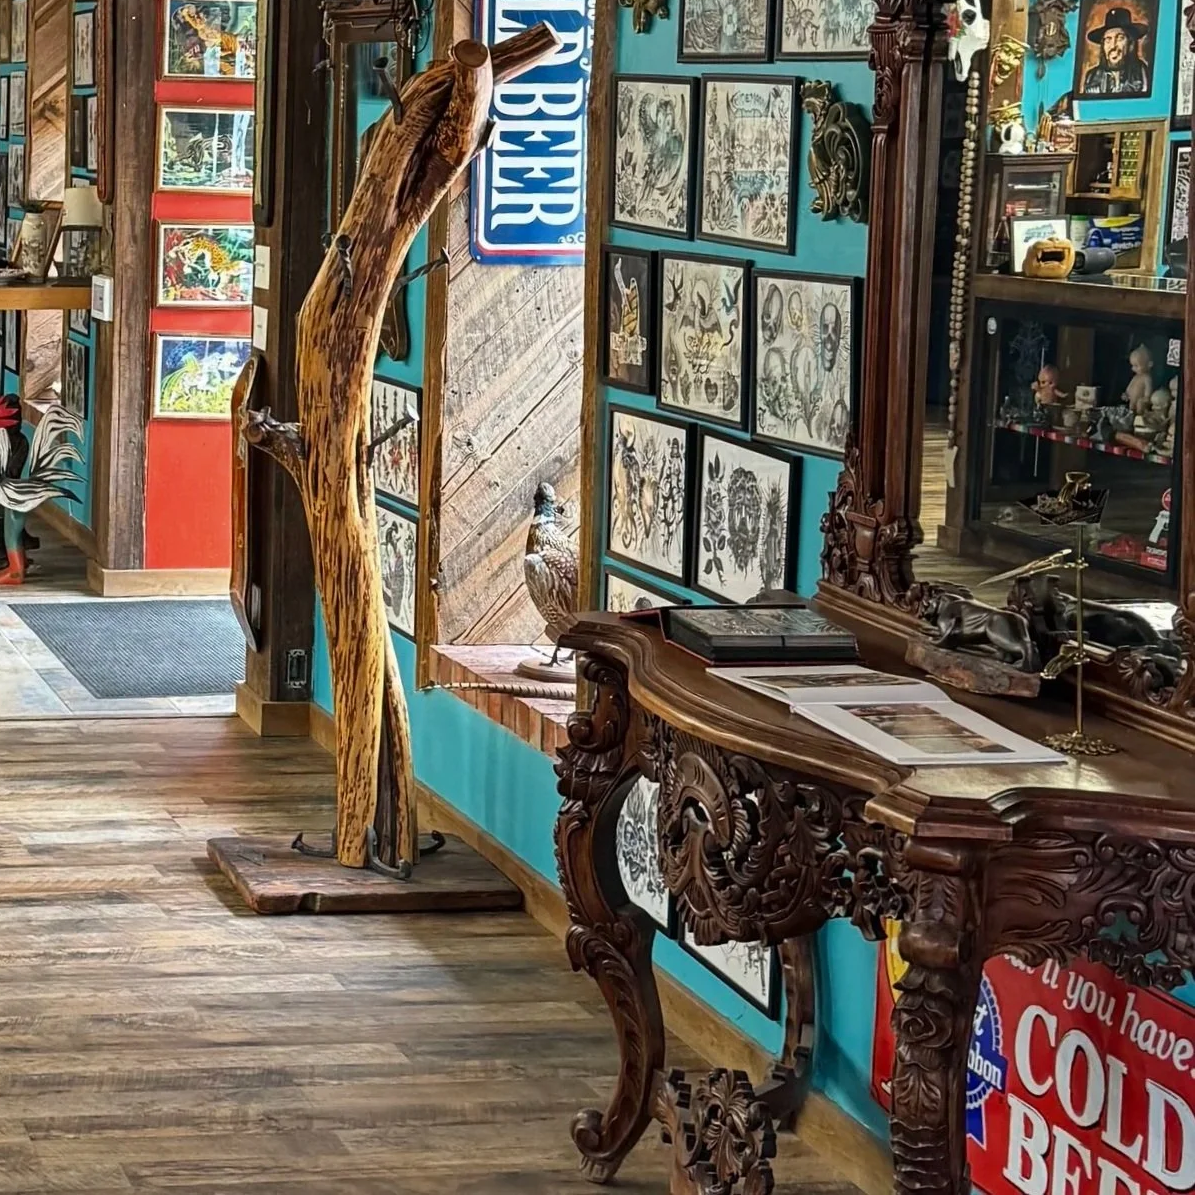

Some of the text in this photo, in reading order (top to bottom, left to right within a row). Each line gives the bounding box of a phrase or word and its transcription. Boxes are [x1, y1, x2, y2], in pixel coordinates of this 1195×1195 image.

[490, 79, 584, 230] BEER
[1015, 1004, 1195, 1190] COLD
[1063, 972, 1116, 1026] you
[1120, 992, 1195, 1080] have
